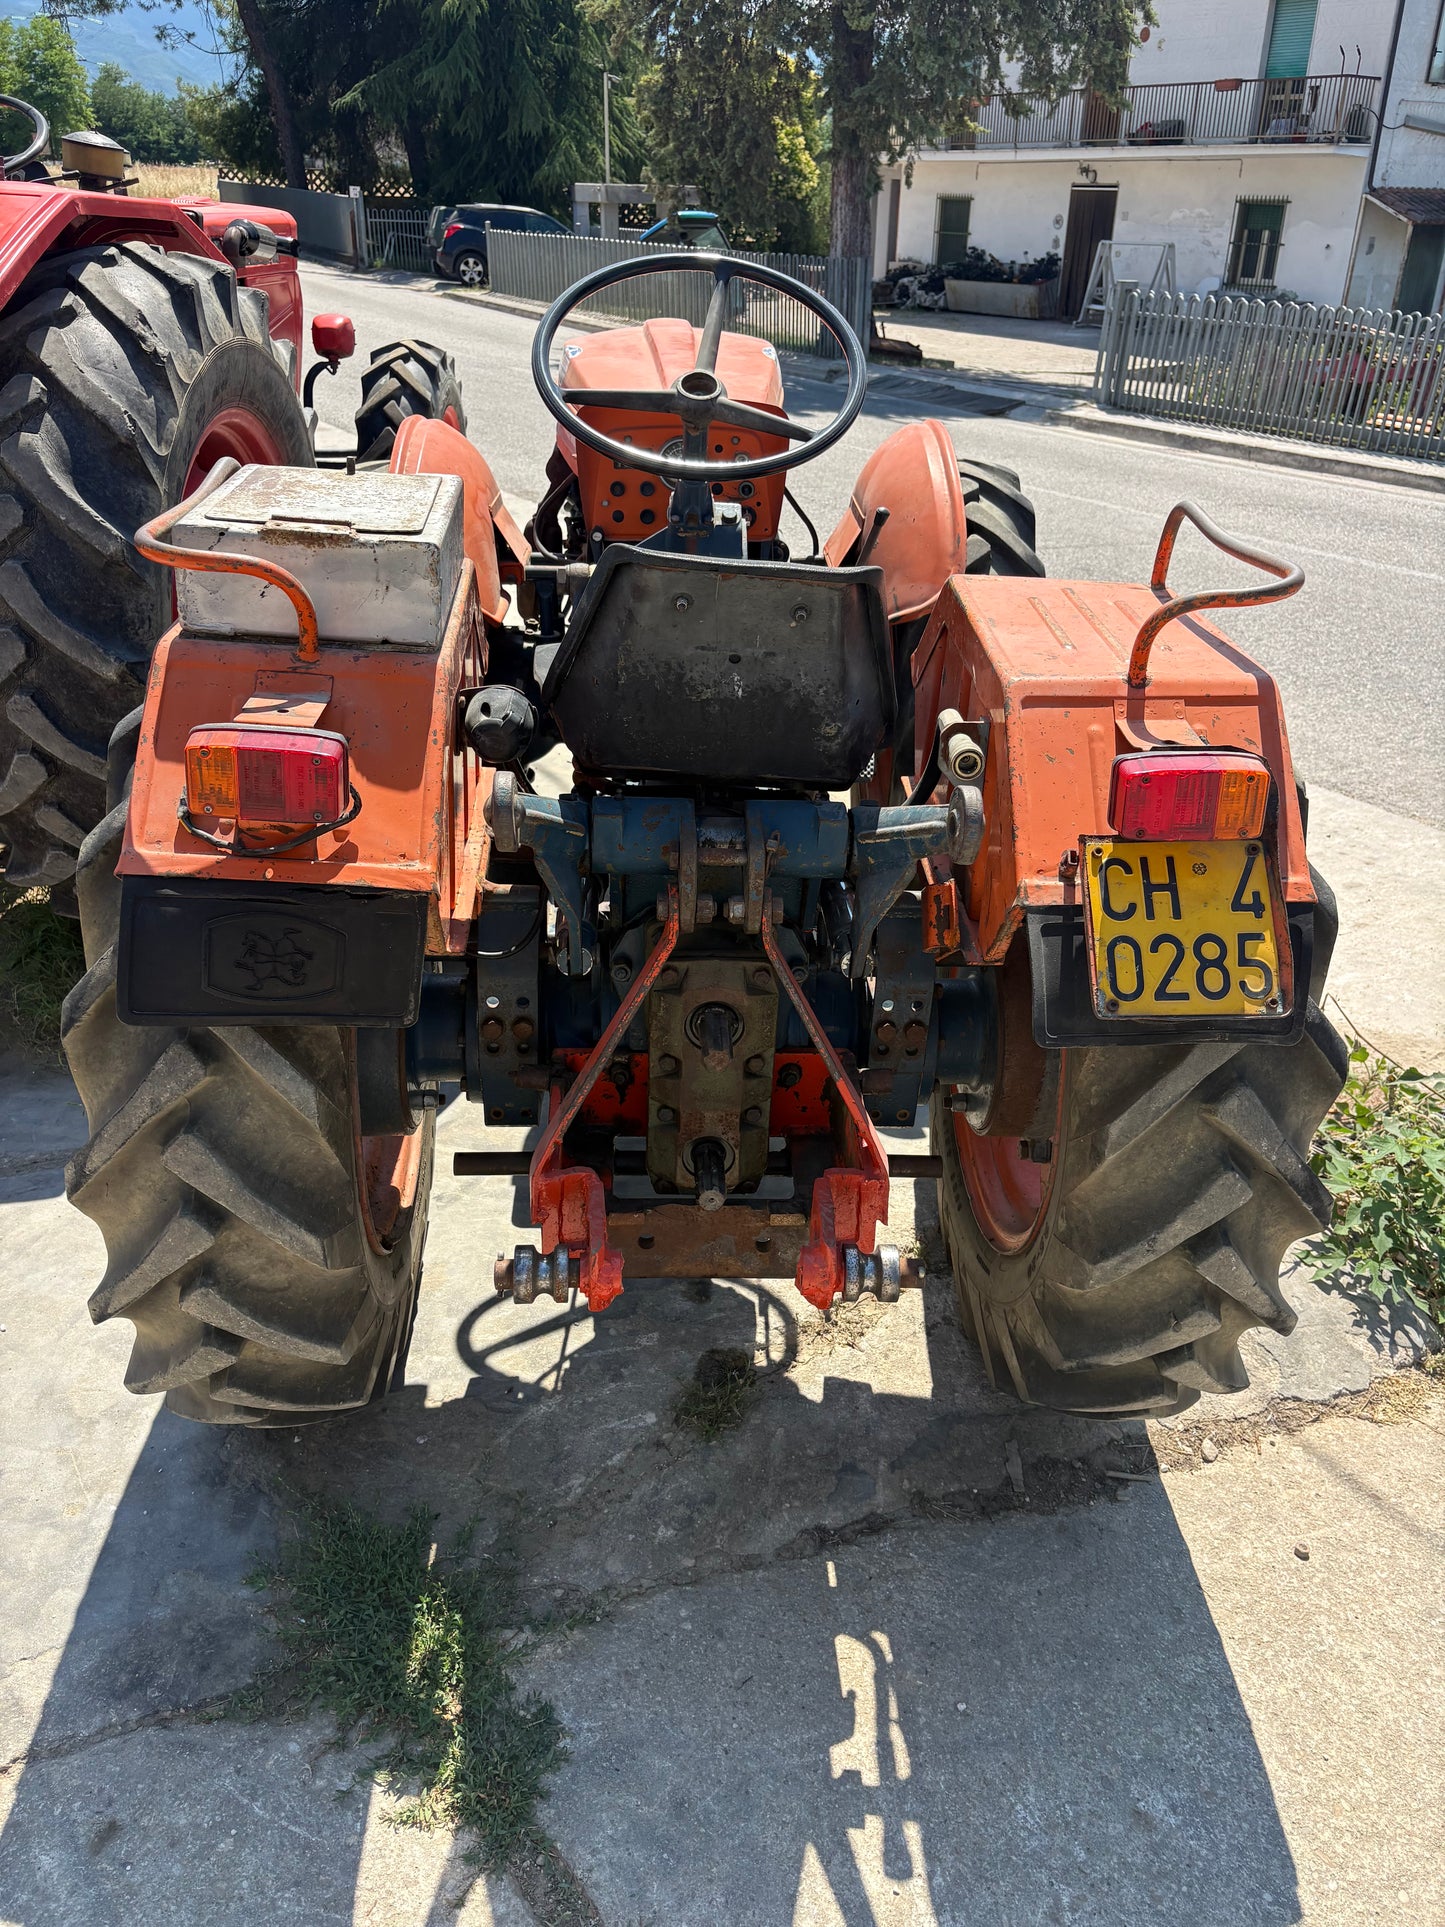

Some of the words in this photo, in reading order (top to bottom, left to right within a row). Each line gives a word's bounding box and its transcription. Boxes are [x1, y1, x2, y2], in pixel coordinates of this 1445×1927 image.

[1099, 856, 1182, 921] CH
[1231, 856, 1266, 919] 4
[1106, 932, 1273, 1001] 0285
